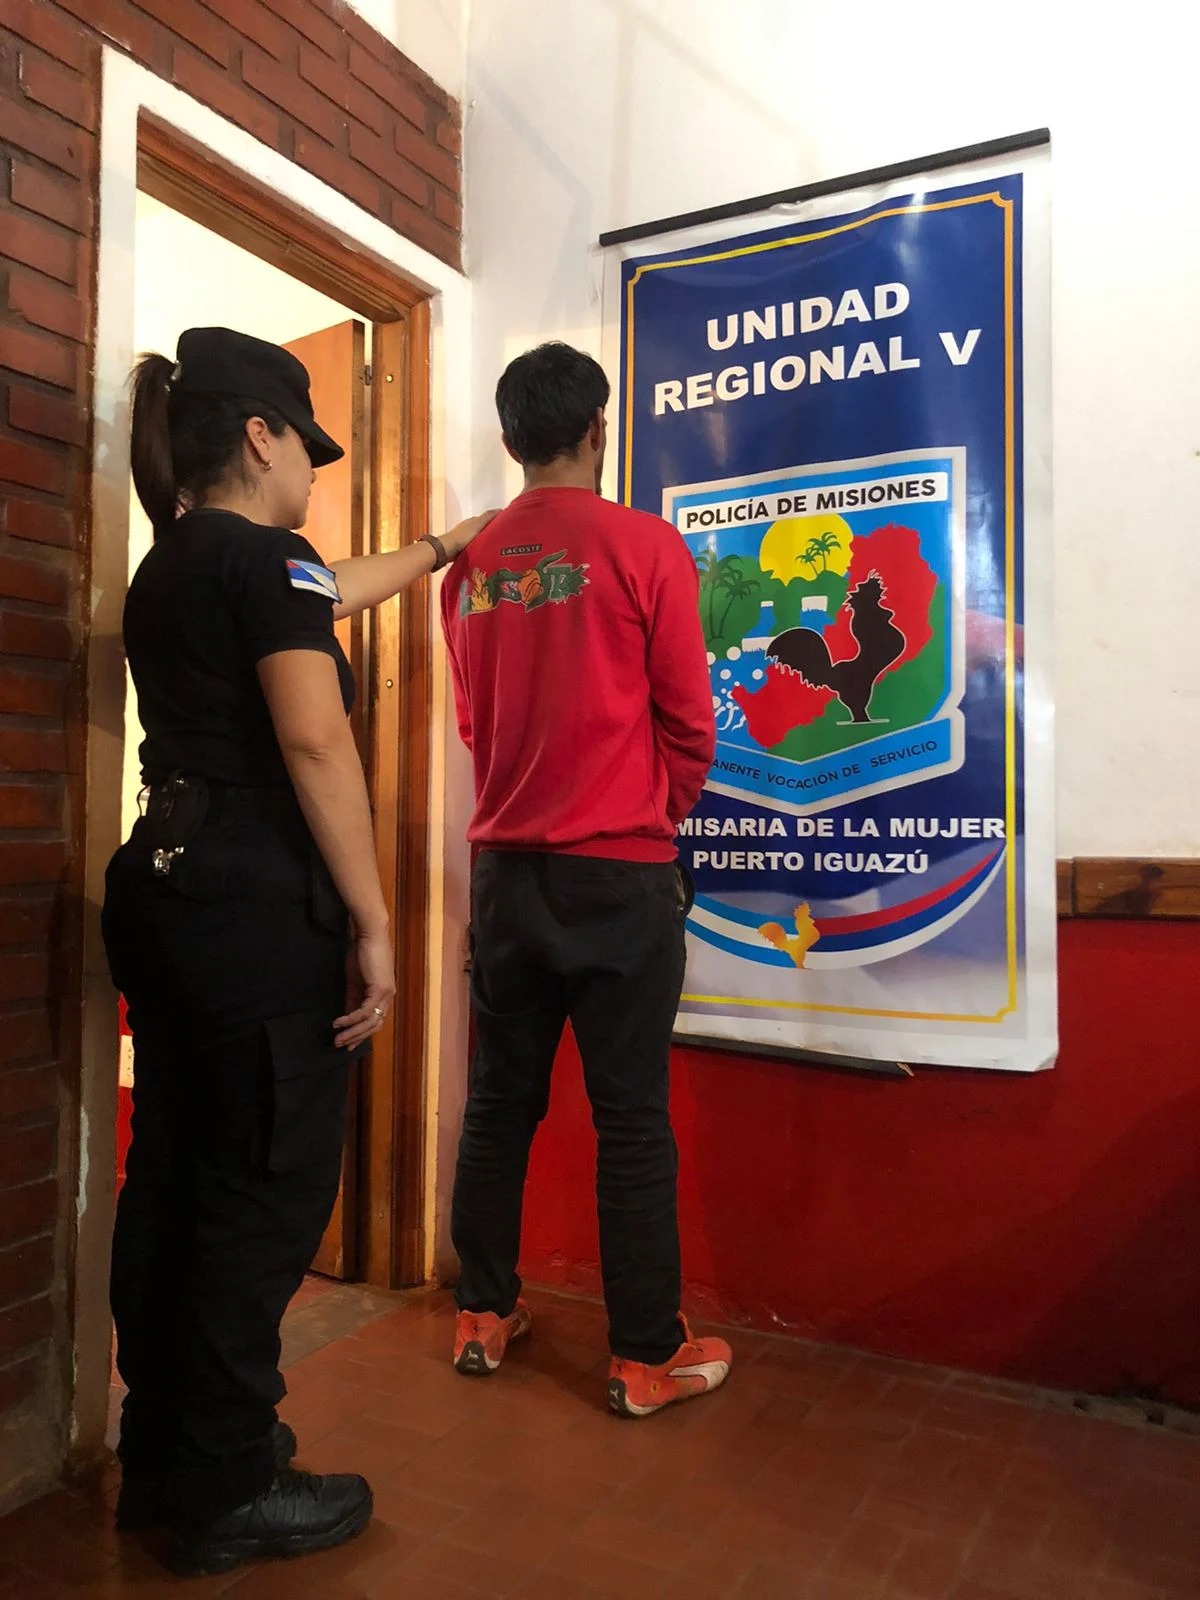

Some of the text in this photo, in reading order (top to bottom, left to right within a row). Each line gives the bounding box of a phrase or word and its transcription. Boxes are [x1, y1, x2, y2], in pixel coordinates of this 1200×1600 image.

[707, 282, 910, 351] UNIDAD
[653, 329, 982, 416] REGIONAL V
[686, 479, 936, 529] POLICÍA DE MISIONES
[712, 759, 760, 779] ANENTE
[842, 763, 861, 777] DE
[870, 740, 937, 768] SERVICIO
[677, 817, 1006, 838] MISARIA DE LA MUJER
[693, 849, 928, 874] PUERTO IGUAZÚ
